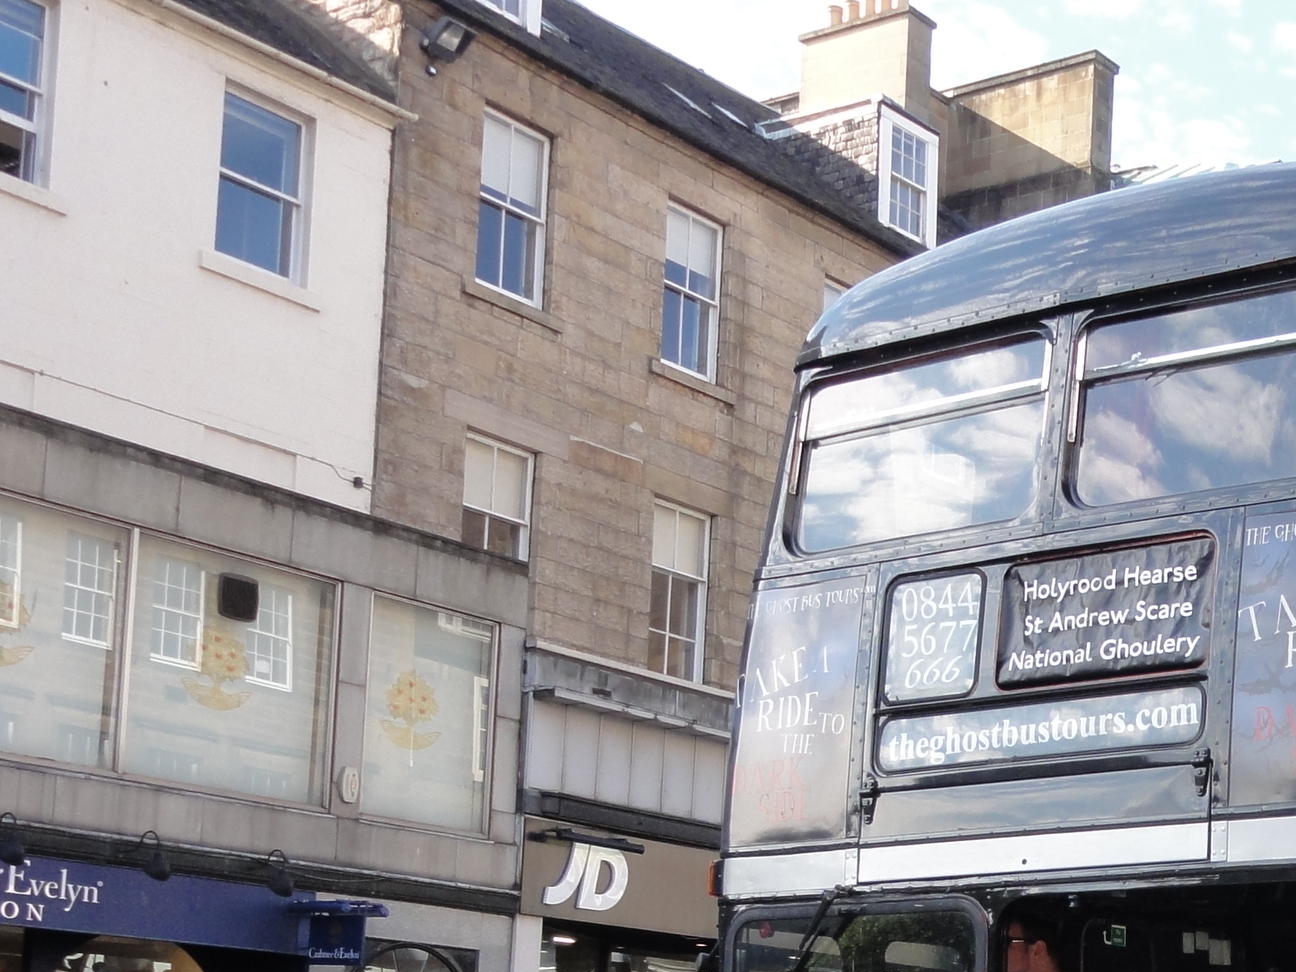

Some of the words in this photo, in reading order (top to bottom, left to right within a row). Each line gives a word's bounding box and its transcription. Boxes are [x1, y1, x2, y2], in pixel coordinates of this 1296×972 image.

[1246, 525, 1271, 546] THE
[801, 592, 823, 610] BUS
[1023, 569, 1116, 602] Holyrood
[1124, 564, 1198, 588] Hearse
[901, 582, 979, 622] 0844
[1024, 615, 1044, 636] St
[1048, 606, 1129, 632] Andrew
[1134, 601, 1194, 620] Scare
[900, 619, 978, 658] 5677
[1008, 643, 1092, 671] National
[1099, 634, 1200, 660] Ghoulery
[813, 645, 830, 674] A
[904, 656, 962, 688] 666
[756, 691, 819, 733] RIDE
[819, 712, 845, 735] TO
[780, 733, 815, 755] THE
[888, 702, 1199, 765] theghostbustours.com
[543, 842, 629, 911] JD
